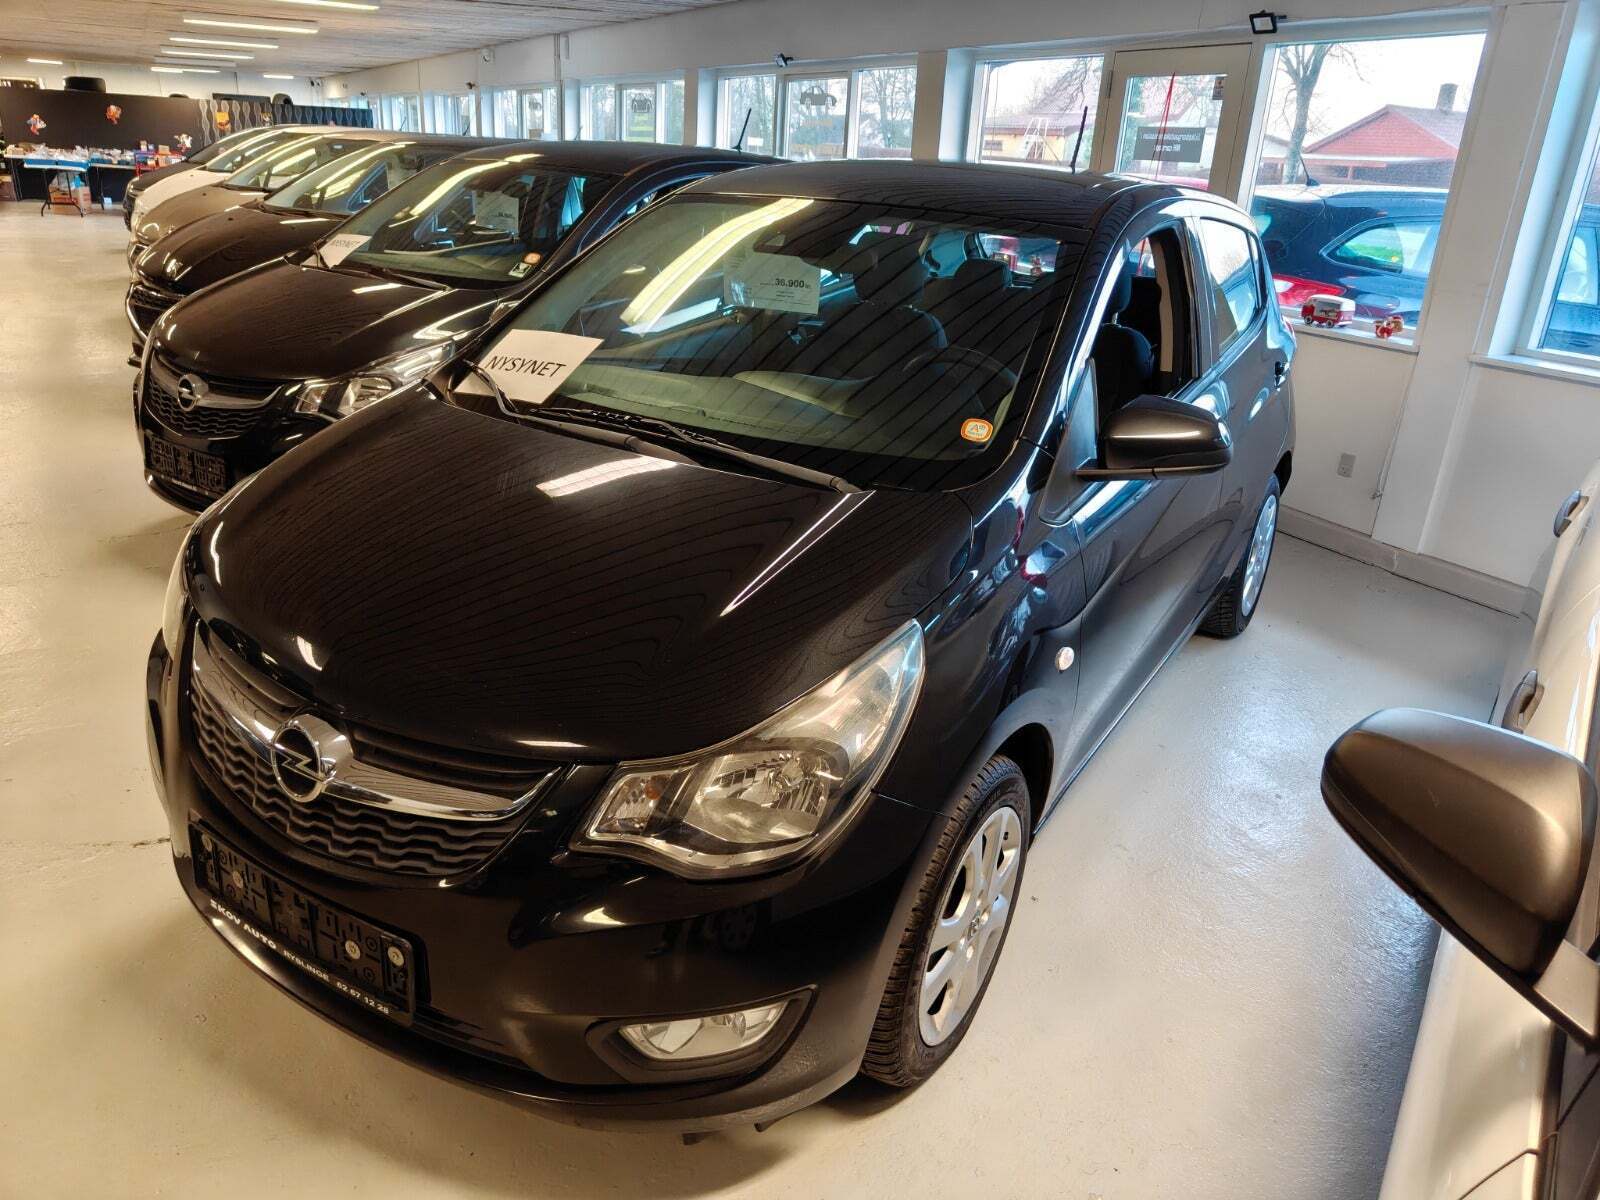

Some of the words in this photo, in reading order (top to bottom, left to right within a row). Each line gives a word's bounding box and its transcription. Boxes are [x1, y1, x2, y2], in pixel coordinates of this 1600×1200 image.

[484, 356, 567, 378] NYSYNET
[209, 898, 241, 925] SKOV
[243, 923, 277, 949] AUTO
[364, 996, 375, 1007] 12
